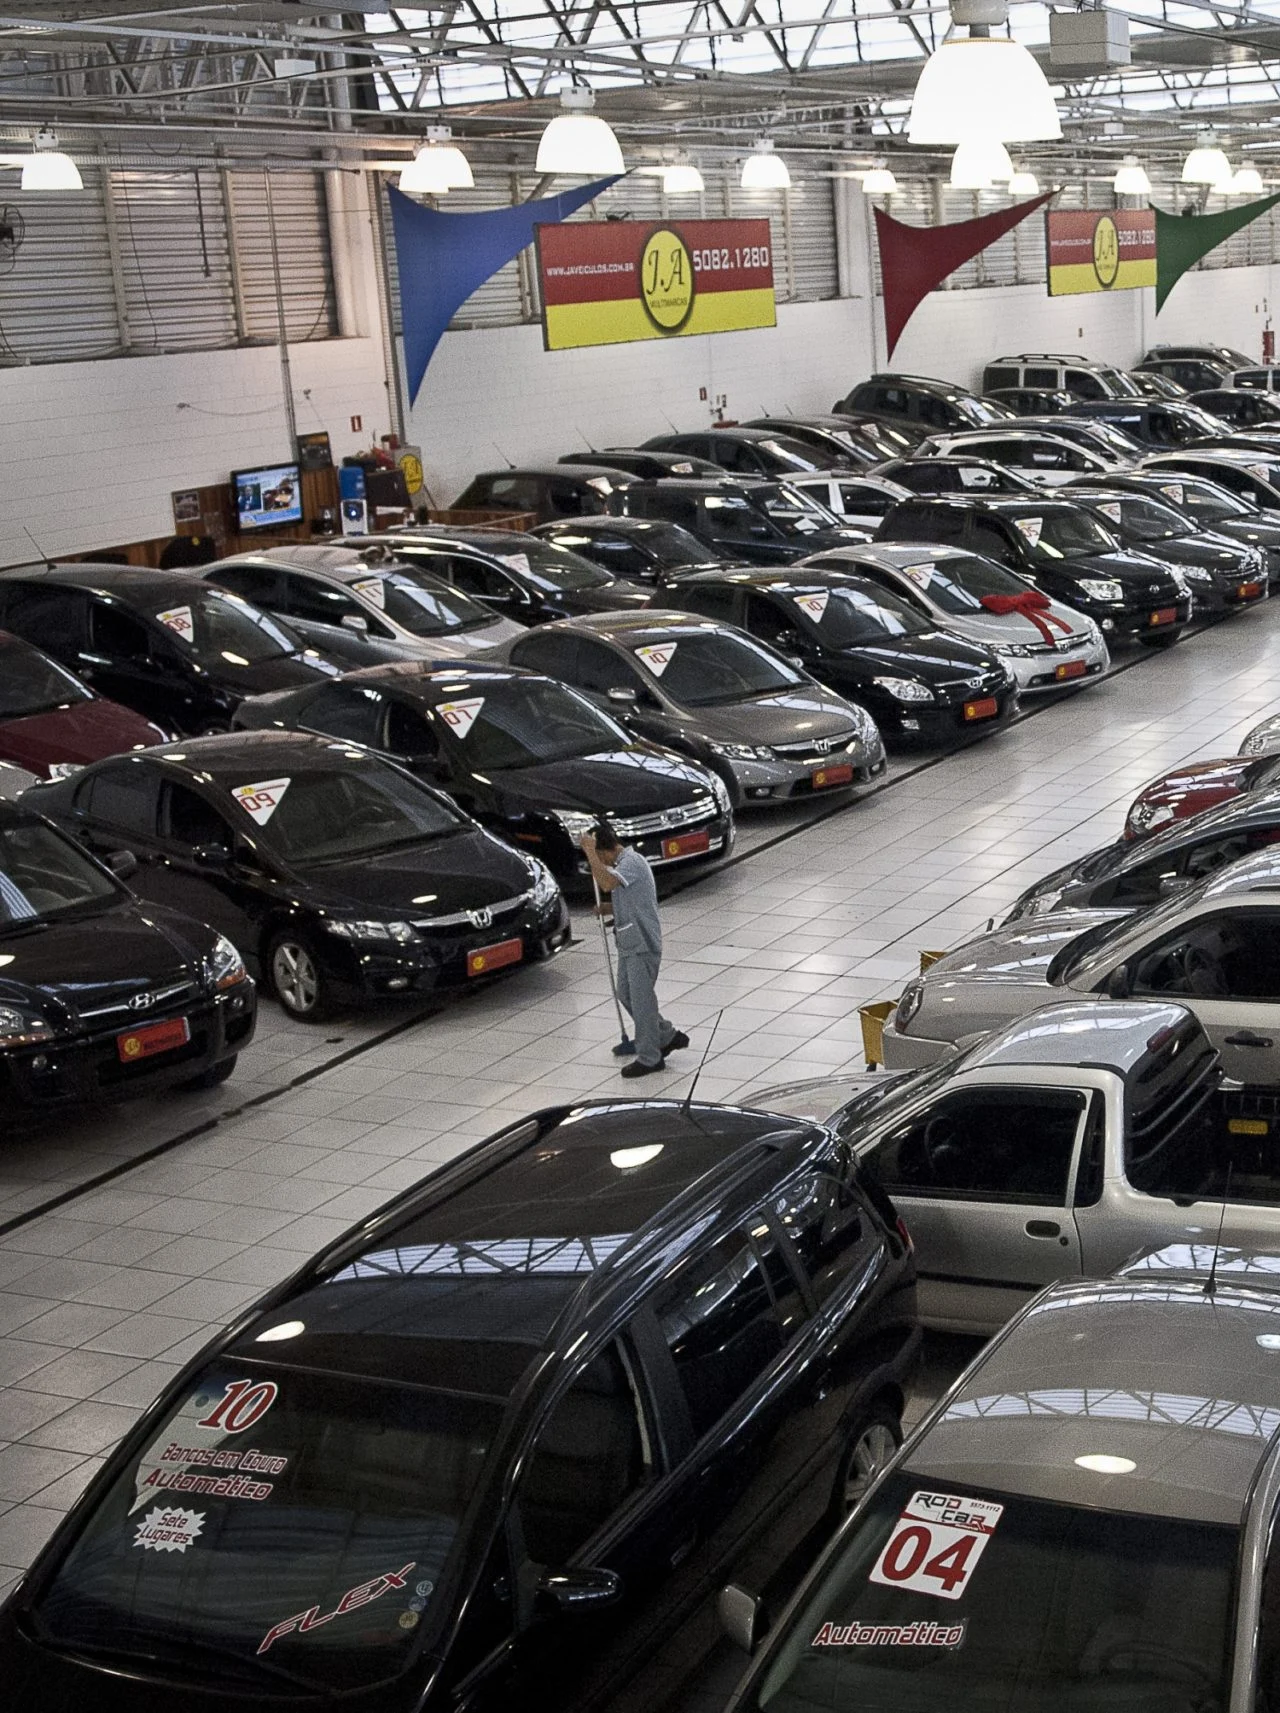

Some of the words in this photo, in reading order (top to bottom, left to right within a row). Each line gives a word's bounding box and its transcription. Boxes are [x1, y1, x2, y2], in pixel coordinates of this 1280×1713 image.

[693, 246, 770, 271] 5082.1280
[443, 709, 474, 726] 07
[240, 792, 276, 811] 09
[196, 1379, 278, 1433] 10
[160, 1443, 212, 1465] Bancos
[212, 1450, 242, 1469] em
[239, 1449, 288, 1474] Couro
[142, 1468, 273, 1500] Automático
[158, 1512, 189, 1529] Sete
[140, 1527, 192, 1544] Lugares
[882, 1525, 978, 1592] 04
[256, 1561, 417, 1655] FLEX
[811, 1621, 964, 1647] Automático
